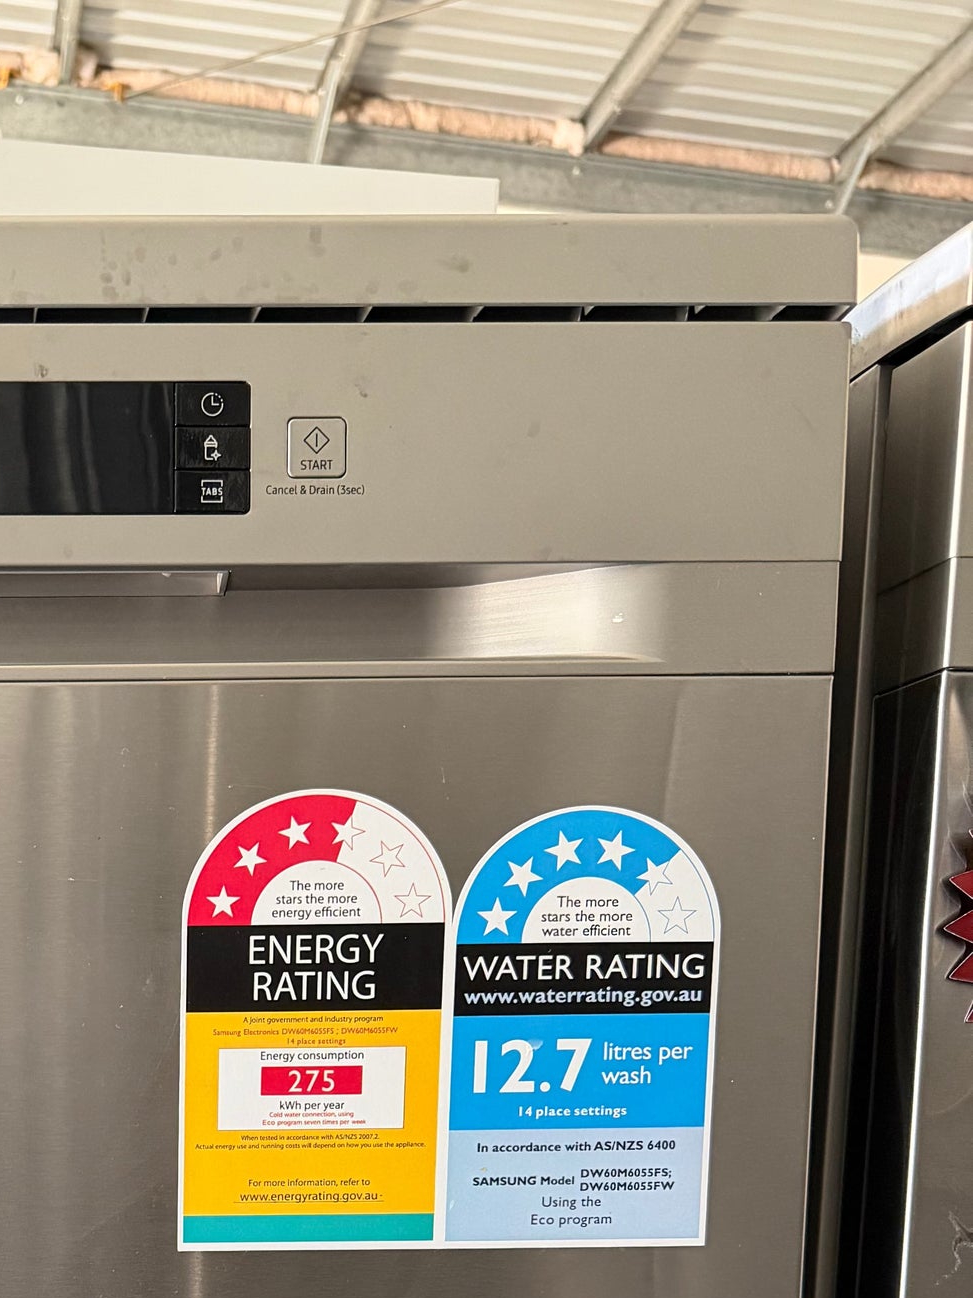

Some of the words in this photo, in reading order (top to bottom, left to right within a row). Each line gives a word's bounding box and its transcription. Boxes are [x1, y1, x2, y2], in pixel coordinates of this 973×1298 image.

[300, 460, 333, 470] START
[201, 487, 223, 496] TABS
[265, 485, 298, 496] Cancel
[300, 486, 307, 495] &
[309, 486, 335, 495] Drain
[337, 484, 365, 496] (3sec)
[289, 880, 312, 891] The
[314, 882, 345, 891] more
[276, 895, 303, 905] stars
[305, 894, 325, 905] the
[327, 895, 358, 904] more
[556, 895, 582, 908] The
[585, 898, 619, 908] more
[271, 908, 312, 920] energy
[314, 907, 361, 918] efficient
[541, 911, 572, 923] stars
[575, 911, 596, 922] the
[599, 912, 633, 922] more
[541, 926, 579, 937] water
[582, 924, 631, 936] efficient
[248, 933, 384, 965] ENERGY
[463, 954, 574, 981] WATER
[585, 953, 705, 979] RATING
[252, 970, 376, 1001] RATING
[464, 986, 703, 1007] www.waterrating.gov.au
[266, 1016, 308, 1025] government
[310, 1015, 323, 1023] and
[353, 1016, 384, 1024] program
[212, 1028, 242, 1037] Samsung
[243, 1028, 280, 1036] Electronics
[297, 1037, 316, 1046] place
[318, 1037, 346, 1045] settings
[260, 1051, 296, 1062] Energy
[297, 1050, 365, 1061] consumption
[602, 1043, 652, 1061] litres
[658, 1044, 693, 1065] per
[472, 1038, 593, 1094] 12.7
[288, 1069, 335, 1093] 275
[601, 1065, 651, 1085] wash
[279, 1100, 302, 1110] kWh
[304, 1102, 321, 1113] per
[323, 1101, 345, 1112] year
[518, 1106, 533, 1117] 14
[535, 1106, 571, 1119] place
[573, 1104, 627, 1119] settings
[338, 1111, 354, 1119] using
[335, 1133, 358, 1141] AS/NZS
[313, 1142, 336, 1150] depend
[396, 1141, 427, 1150] appliance.
[476, 1142, 489, 1153] In
[491, 1142, 562, 1152] accordance
[564, 1141, 592, 1151] with
[594, 1140, 644, 1151] AS/NZS
[646, 1140, 676, 1150] 6400
[580, 1168, 672, 1179] DW60M6055FS;
[248, 1179, 262, 1188] For
[287, 1178, 339, 1188] information,
[340, 1178, 360, 1187] refer
[472, 1175, 537, 1186] SAMSUNG
[540, 1175, 575, 1186] Model
[579, 1181, 675, 1192] DW60M6055FW
[541, 1196, 577, 1210] Using
[580, 1195, 602, 1207] the
[530, 1214, 555, 1225] Eco
[558, 1215, 613, 1227] program
